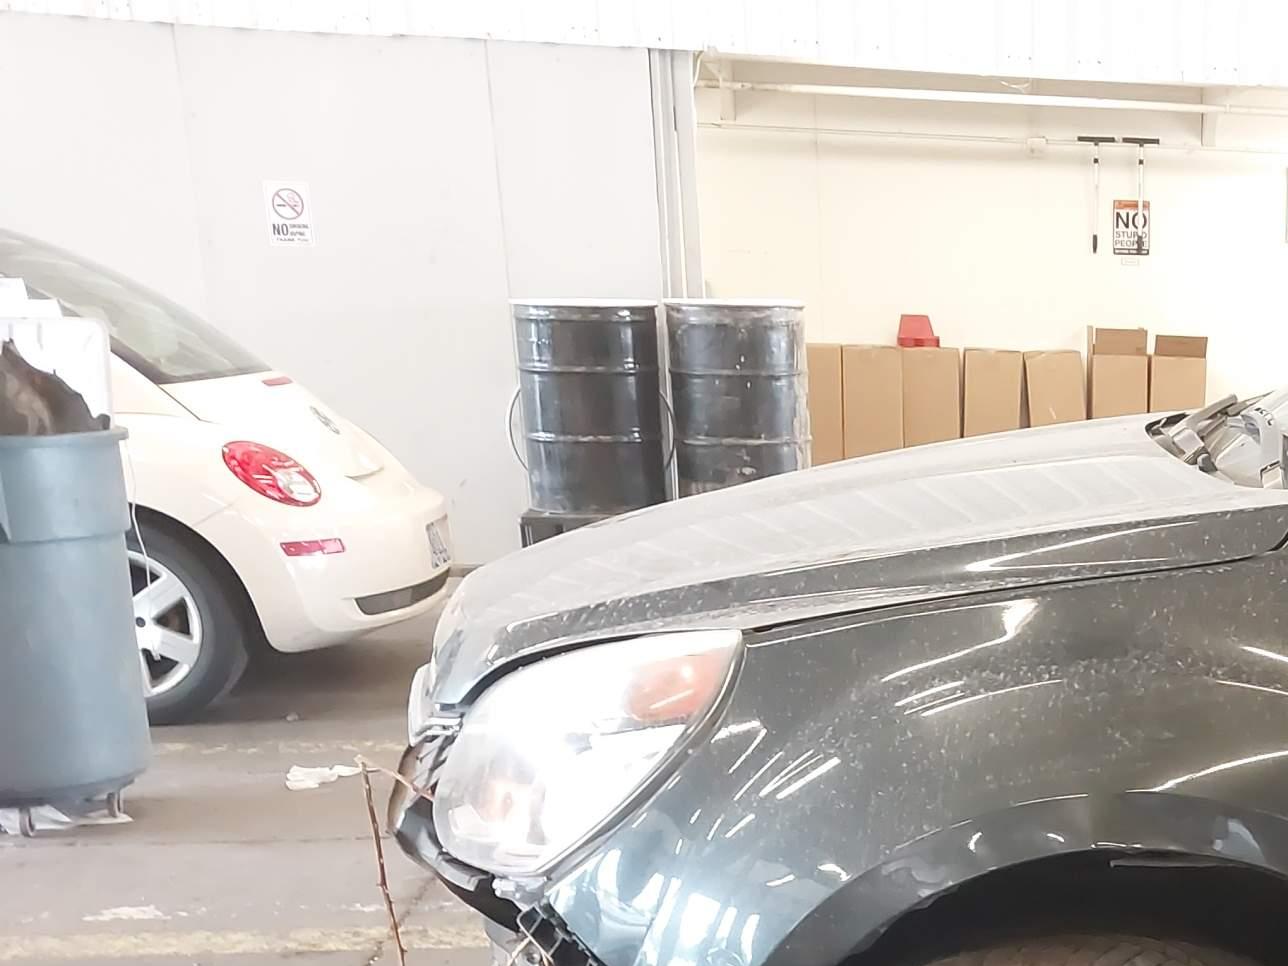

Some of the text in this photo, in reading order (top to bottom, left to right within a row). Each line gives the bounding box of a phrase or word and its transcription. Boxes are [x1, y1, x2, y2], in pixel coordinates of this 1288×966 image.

[1115, 211, 1148, 229] NO
[272, 223, 289, 236] NO
[1115, 230, 1148, 239] STUPD
[1114, 239, 1148, 248] PEOPE
